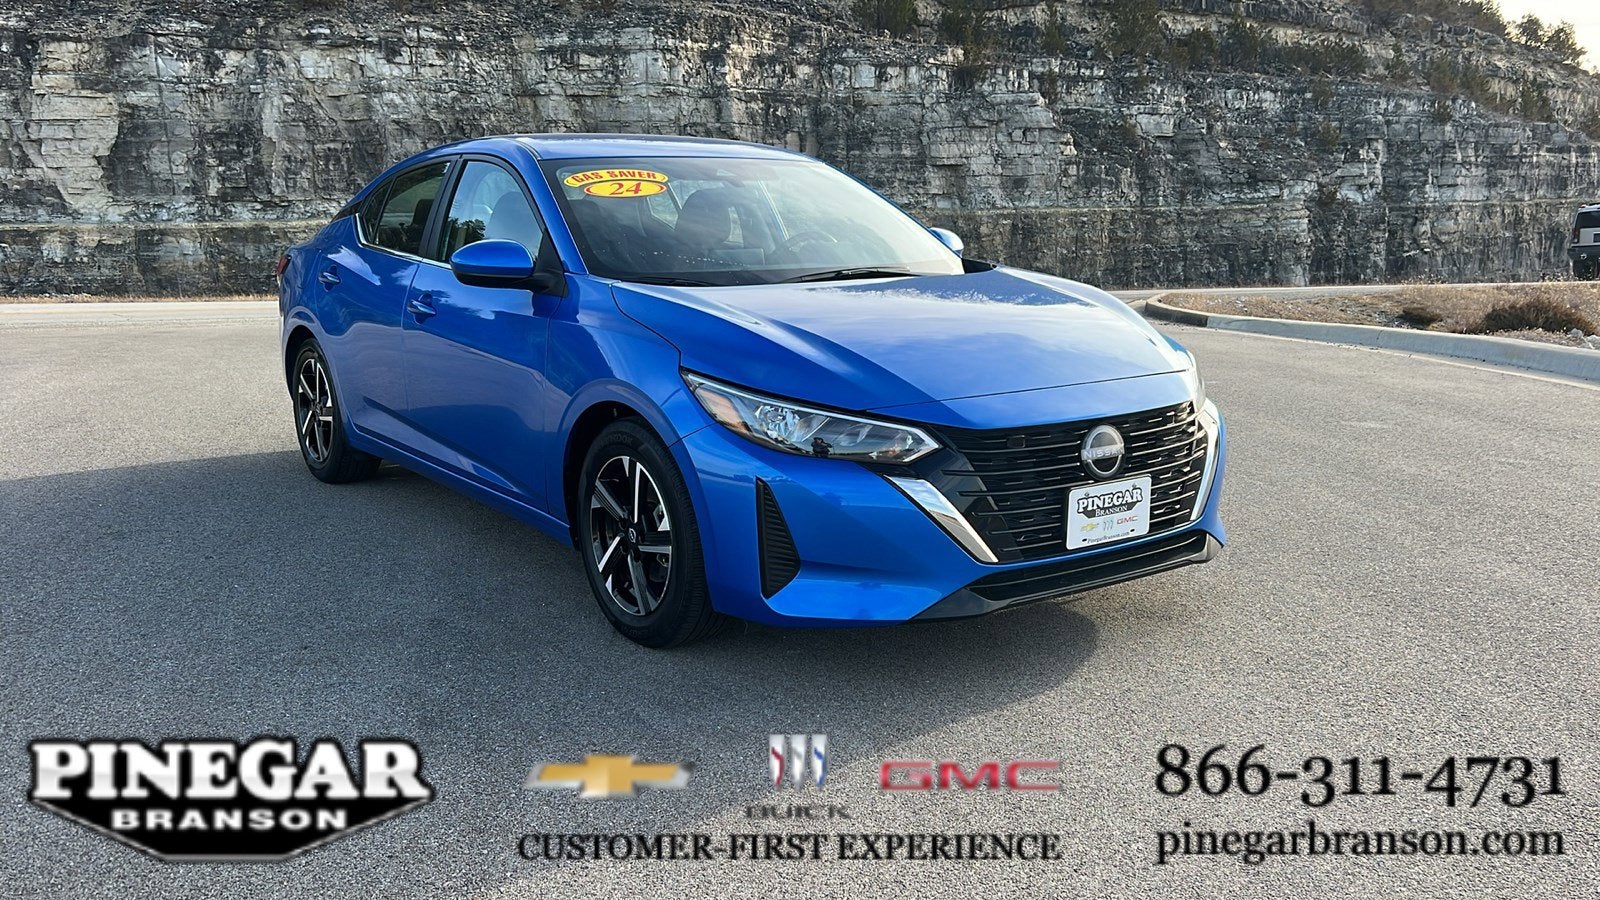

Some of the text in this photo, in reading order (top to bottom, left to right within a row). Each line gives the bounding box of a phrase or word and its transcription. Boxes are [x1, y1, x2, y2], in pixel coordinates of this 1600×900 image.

[571, 170, 657, 183] GAS SAVER
[609, 182, 642, 195] 24
[1077, 488, 1143, 513] PINEGAR
[1095, 505, 1128, 517] BRANSON
[1116, 516, 1138, 525] GMC
